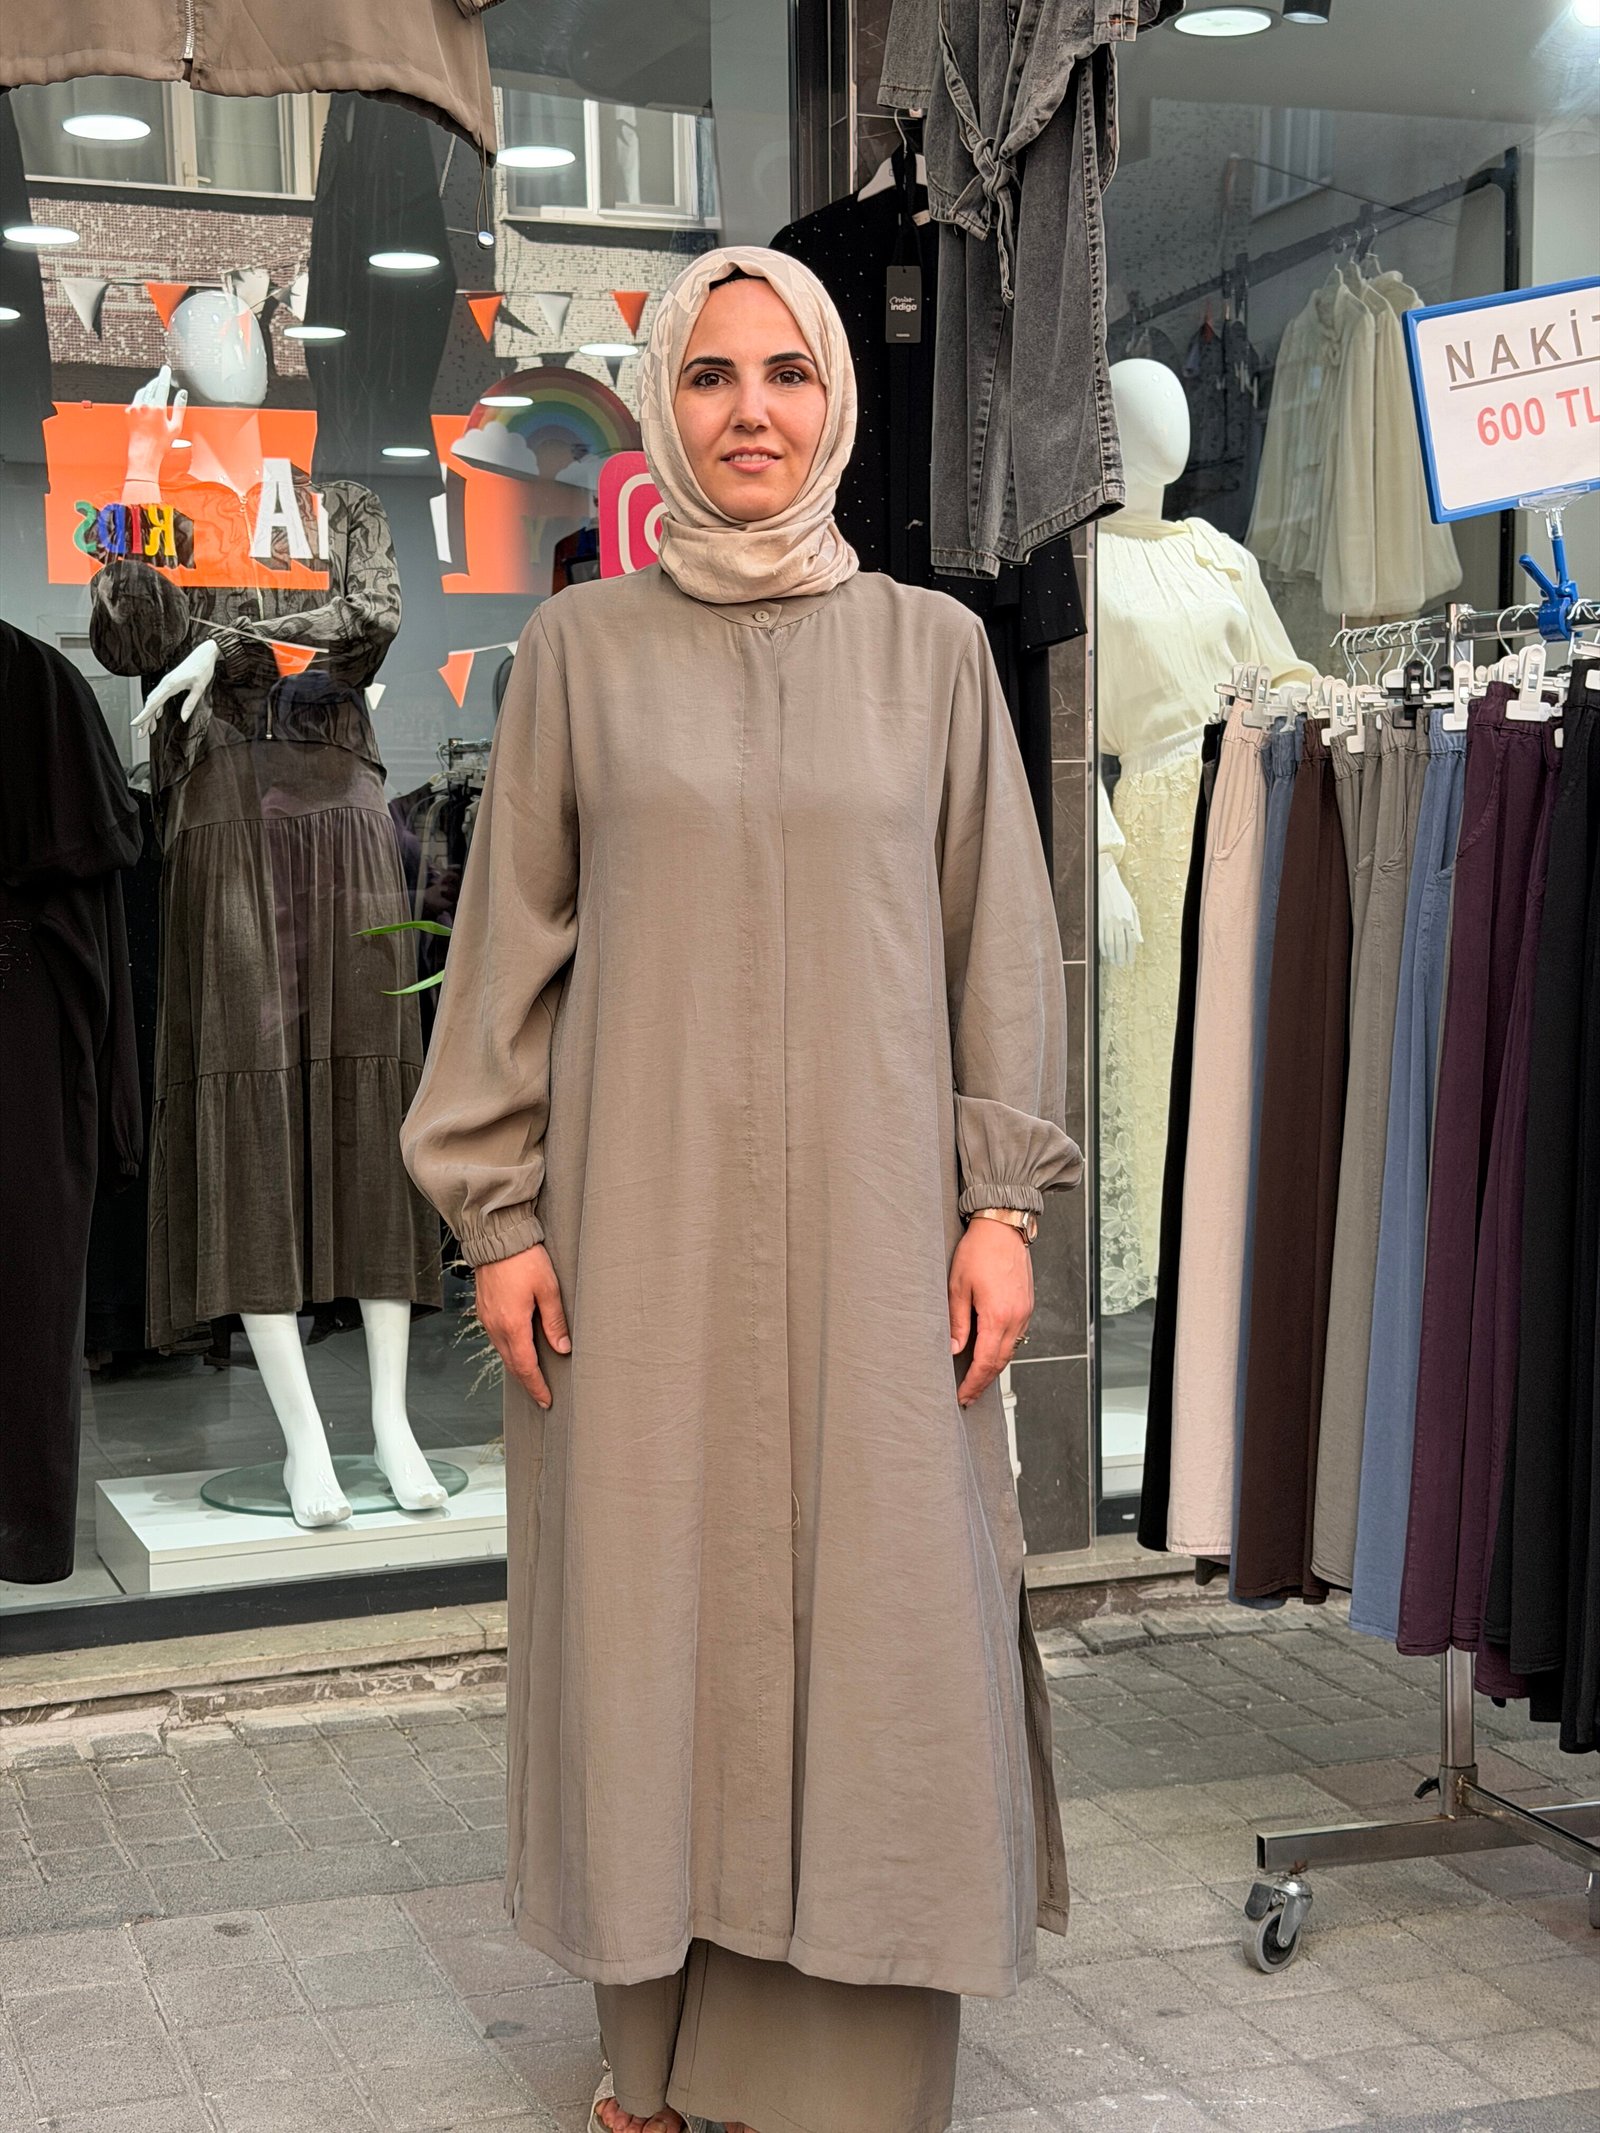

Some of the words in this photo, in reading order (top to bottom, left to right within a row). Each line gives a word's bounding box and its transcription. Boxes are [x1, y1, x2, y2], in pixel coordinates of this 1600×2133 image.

[890, 303, 917, 312] indigo
[1477, 397, 1546, 446] 600
[1556, 386, 1600, 428] TL
